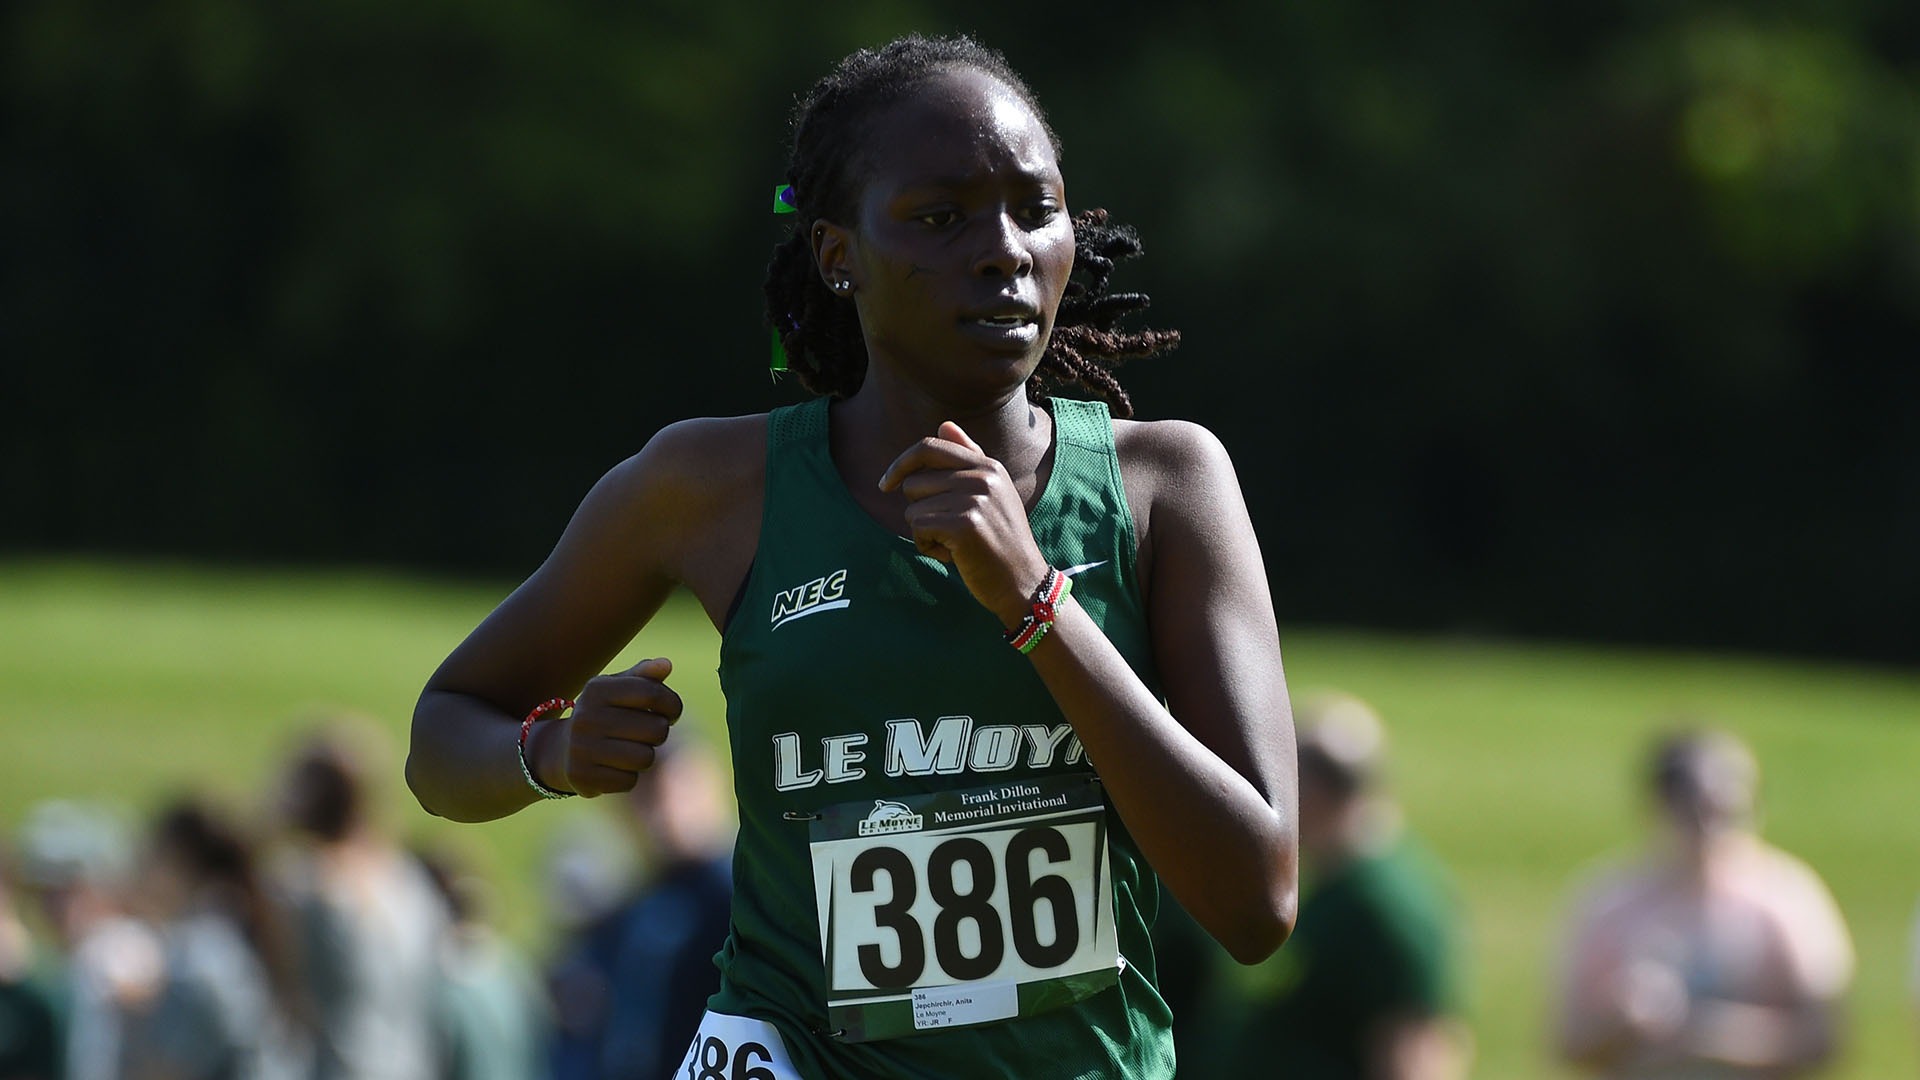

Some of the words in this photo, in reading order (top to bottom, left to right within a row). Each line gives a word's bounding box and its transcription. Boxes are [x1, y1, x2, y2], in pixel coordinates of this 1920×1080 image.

[770, 569, 848, 624] NEC
[772, 731, 869, 792] LE
[934, 806, 995, 824] Memorial
[997, 794, 1068, 815] Invitational
[961, 789, 998, 805] Frank
[1001, 784, 1041, 800] Dillon
[850, 826, 1080, 989] 386
[925, 1010, 946, 1018] Moyne
